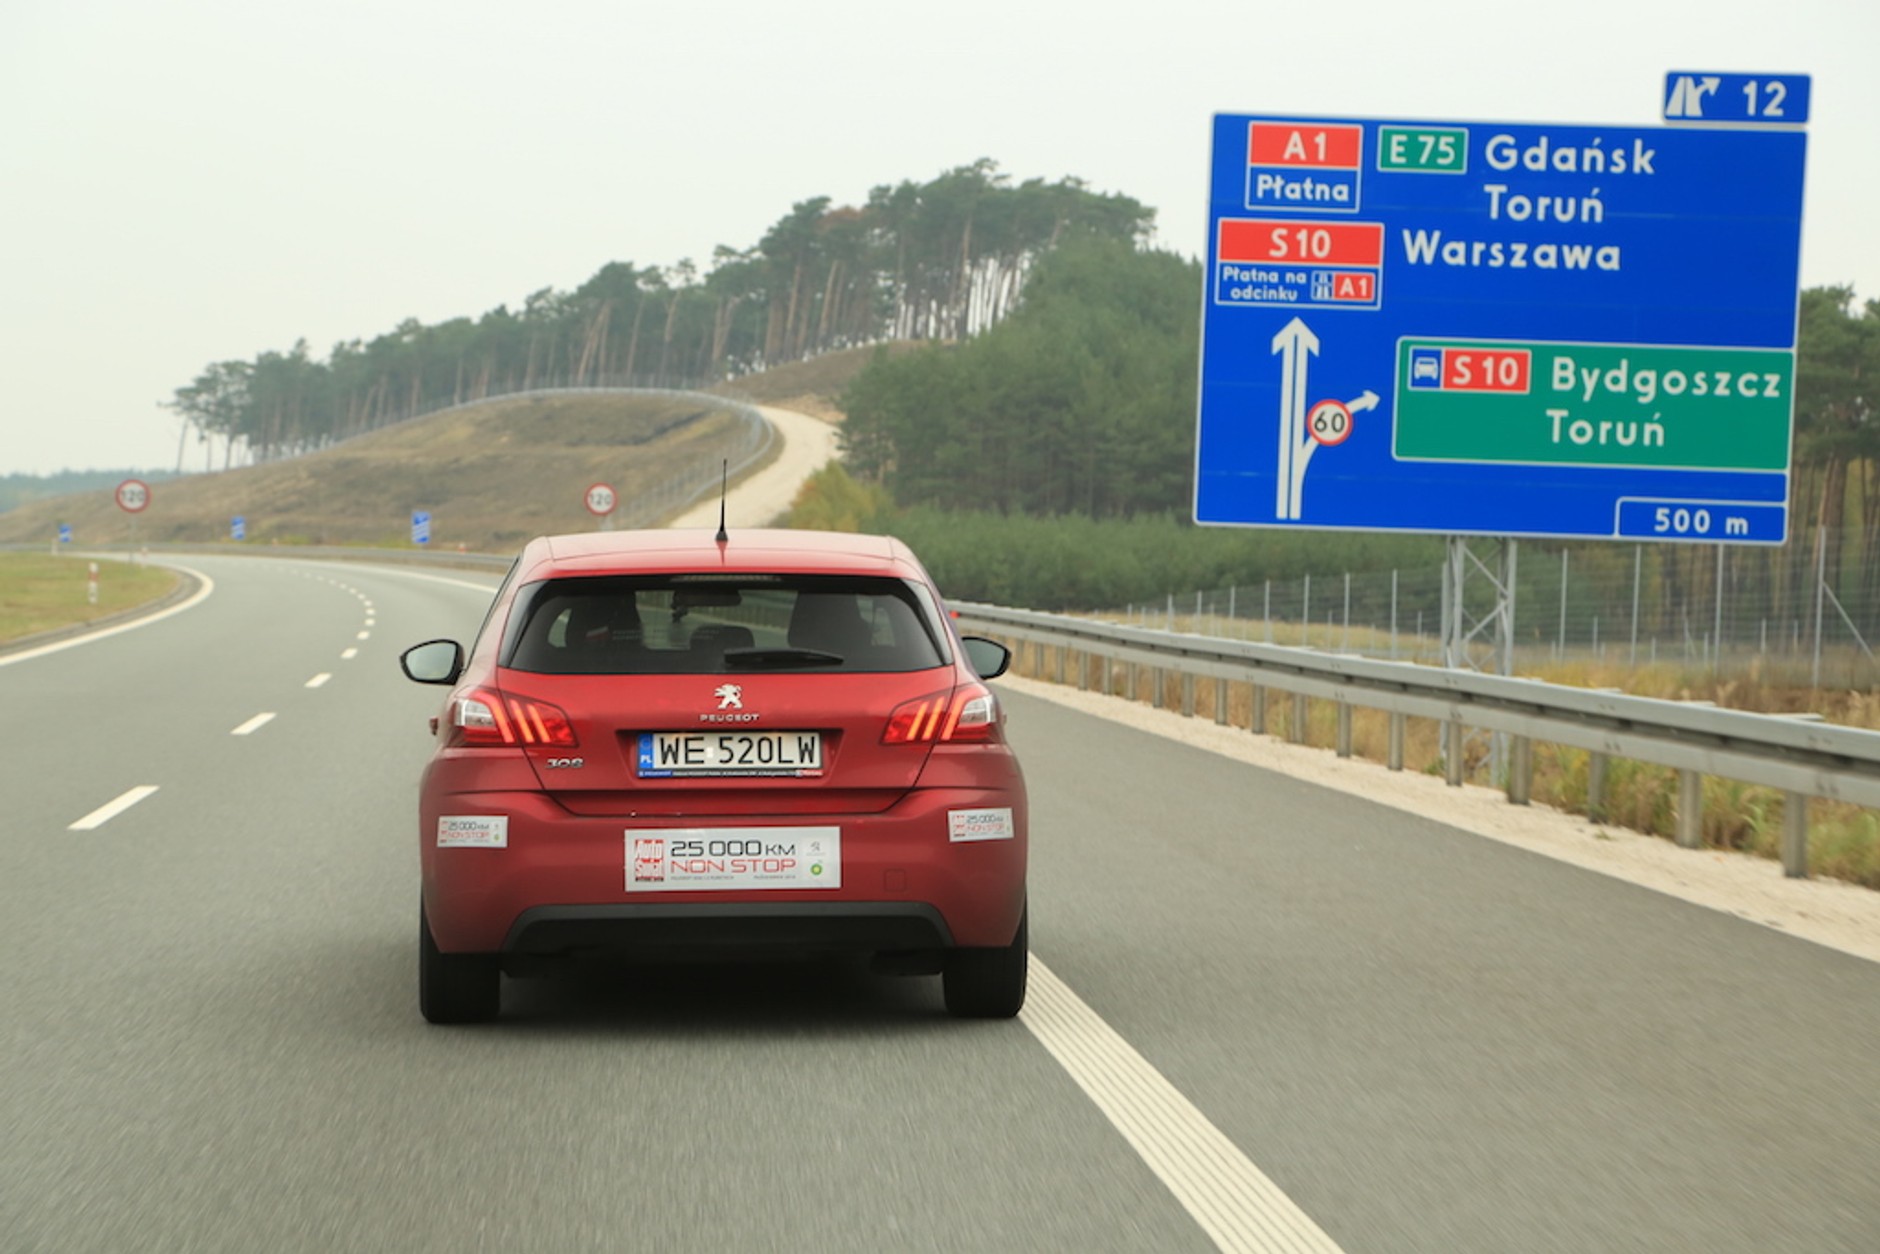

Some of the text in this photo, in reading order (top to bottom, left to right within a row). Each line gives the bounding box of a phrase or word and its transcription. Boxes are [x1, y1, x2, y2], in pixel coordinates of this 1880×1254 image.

[1743, 80, 1787, 117] 12
[1485, 134, 1656, 175] Gdańsk
[1256, 174, 1350, 202] Płatna
[1483, 184, 1604, 223] Toruń
[1402, 229, 1621, 271] Warszawa
[1222, 265, 1307, 285] Płatna na
[1230, 285, 1298, 302] odcinku
[1551, 357, 1781, 404] Bydgoszcz
[1313, 411, 1346, 434] 60
[1546, 409, 1665, 446] Toruń
[120, 488, 147, 504] 120
[590, 492, 612, 507] 120
[1655, 508, 1749, 536] 500 m
[700, 713, 760, 722] PEUGEOT
[640, 754, 653, 764] PL
[660, 736, 816, 765] WE 520LW
[545, 758, 584, 769] 308
[671, 840, 796, 857] 25 000 KM
[671, 858, 796, 873] NON STOP
